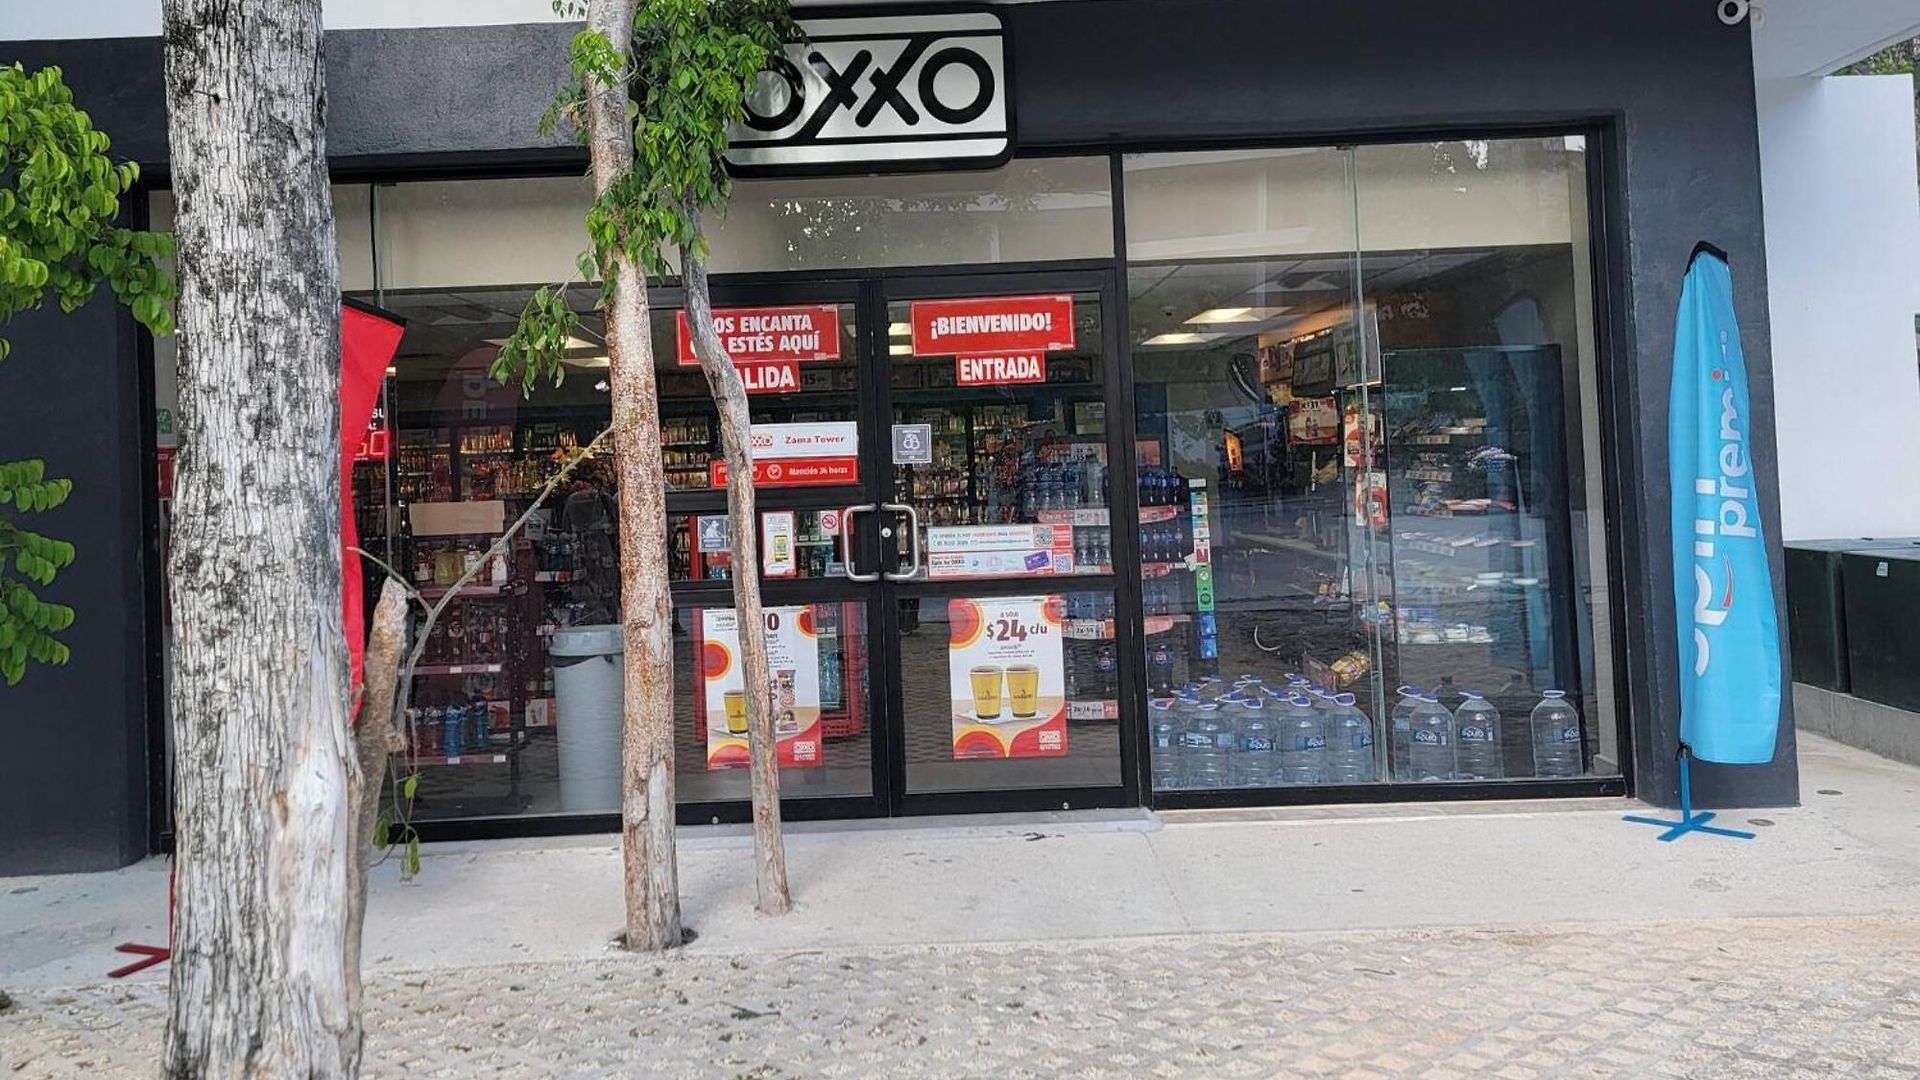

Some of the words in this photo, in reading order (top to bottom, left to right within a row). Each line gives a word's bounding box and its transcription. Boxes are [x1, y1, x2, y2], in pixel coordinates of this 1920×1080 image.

[742, 38, 995, 138] OXXO
[714, 317, 735, 334] OS
[740, 315, 813, 333] ENCANTA
[931, 312, 1052, 340] ¡BIENVENIDO!
[728, 332, 774, 353] ESTÉS
[779, 330, 820, 355] AQUÍ
[736, 366, 796, 389] LIDA
[960, 356, 1041, 381] ENTRADA
[785, 436, 811, 444] Zama
[815, 434, 846, 443] Tower
[828, 465, 848, 475] horas
[1029, 623, 1048, 635] c/u
